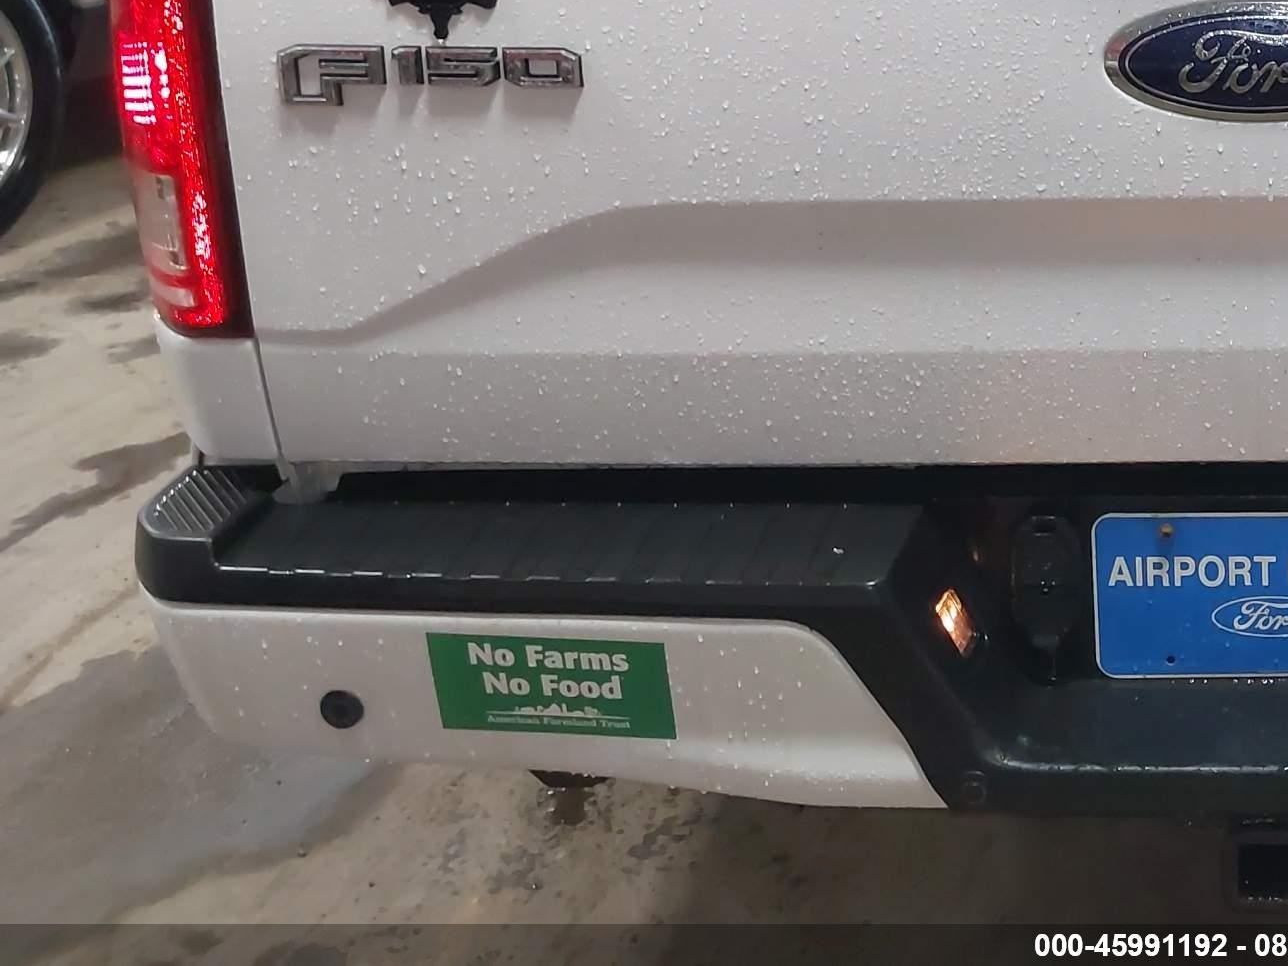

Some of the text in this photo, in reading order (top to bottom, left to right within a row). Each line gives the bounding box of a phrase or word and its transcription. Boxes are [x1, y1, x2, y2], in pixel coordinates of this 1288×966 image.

[1107, 555, 1277, 587] AIRPORT
[467, 642, 630, 672] No Farms
[482, 671, 624, 700] No Food
